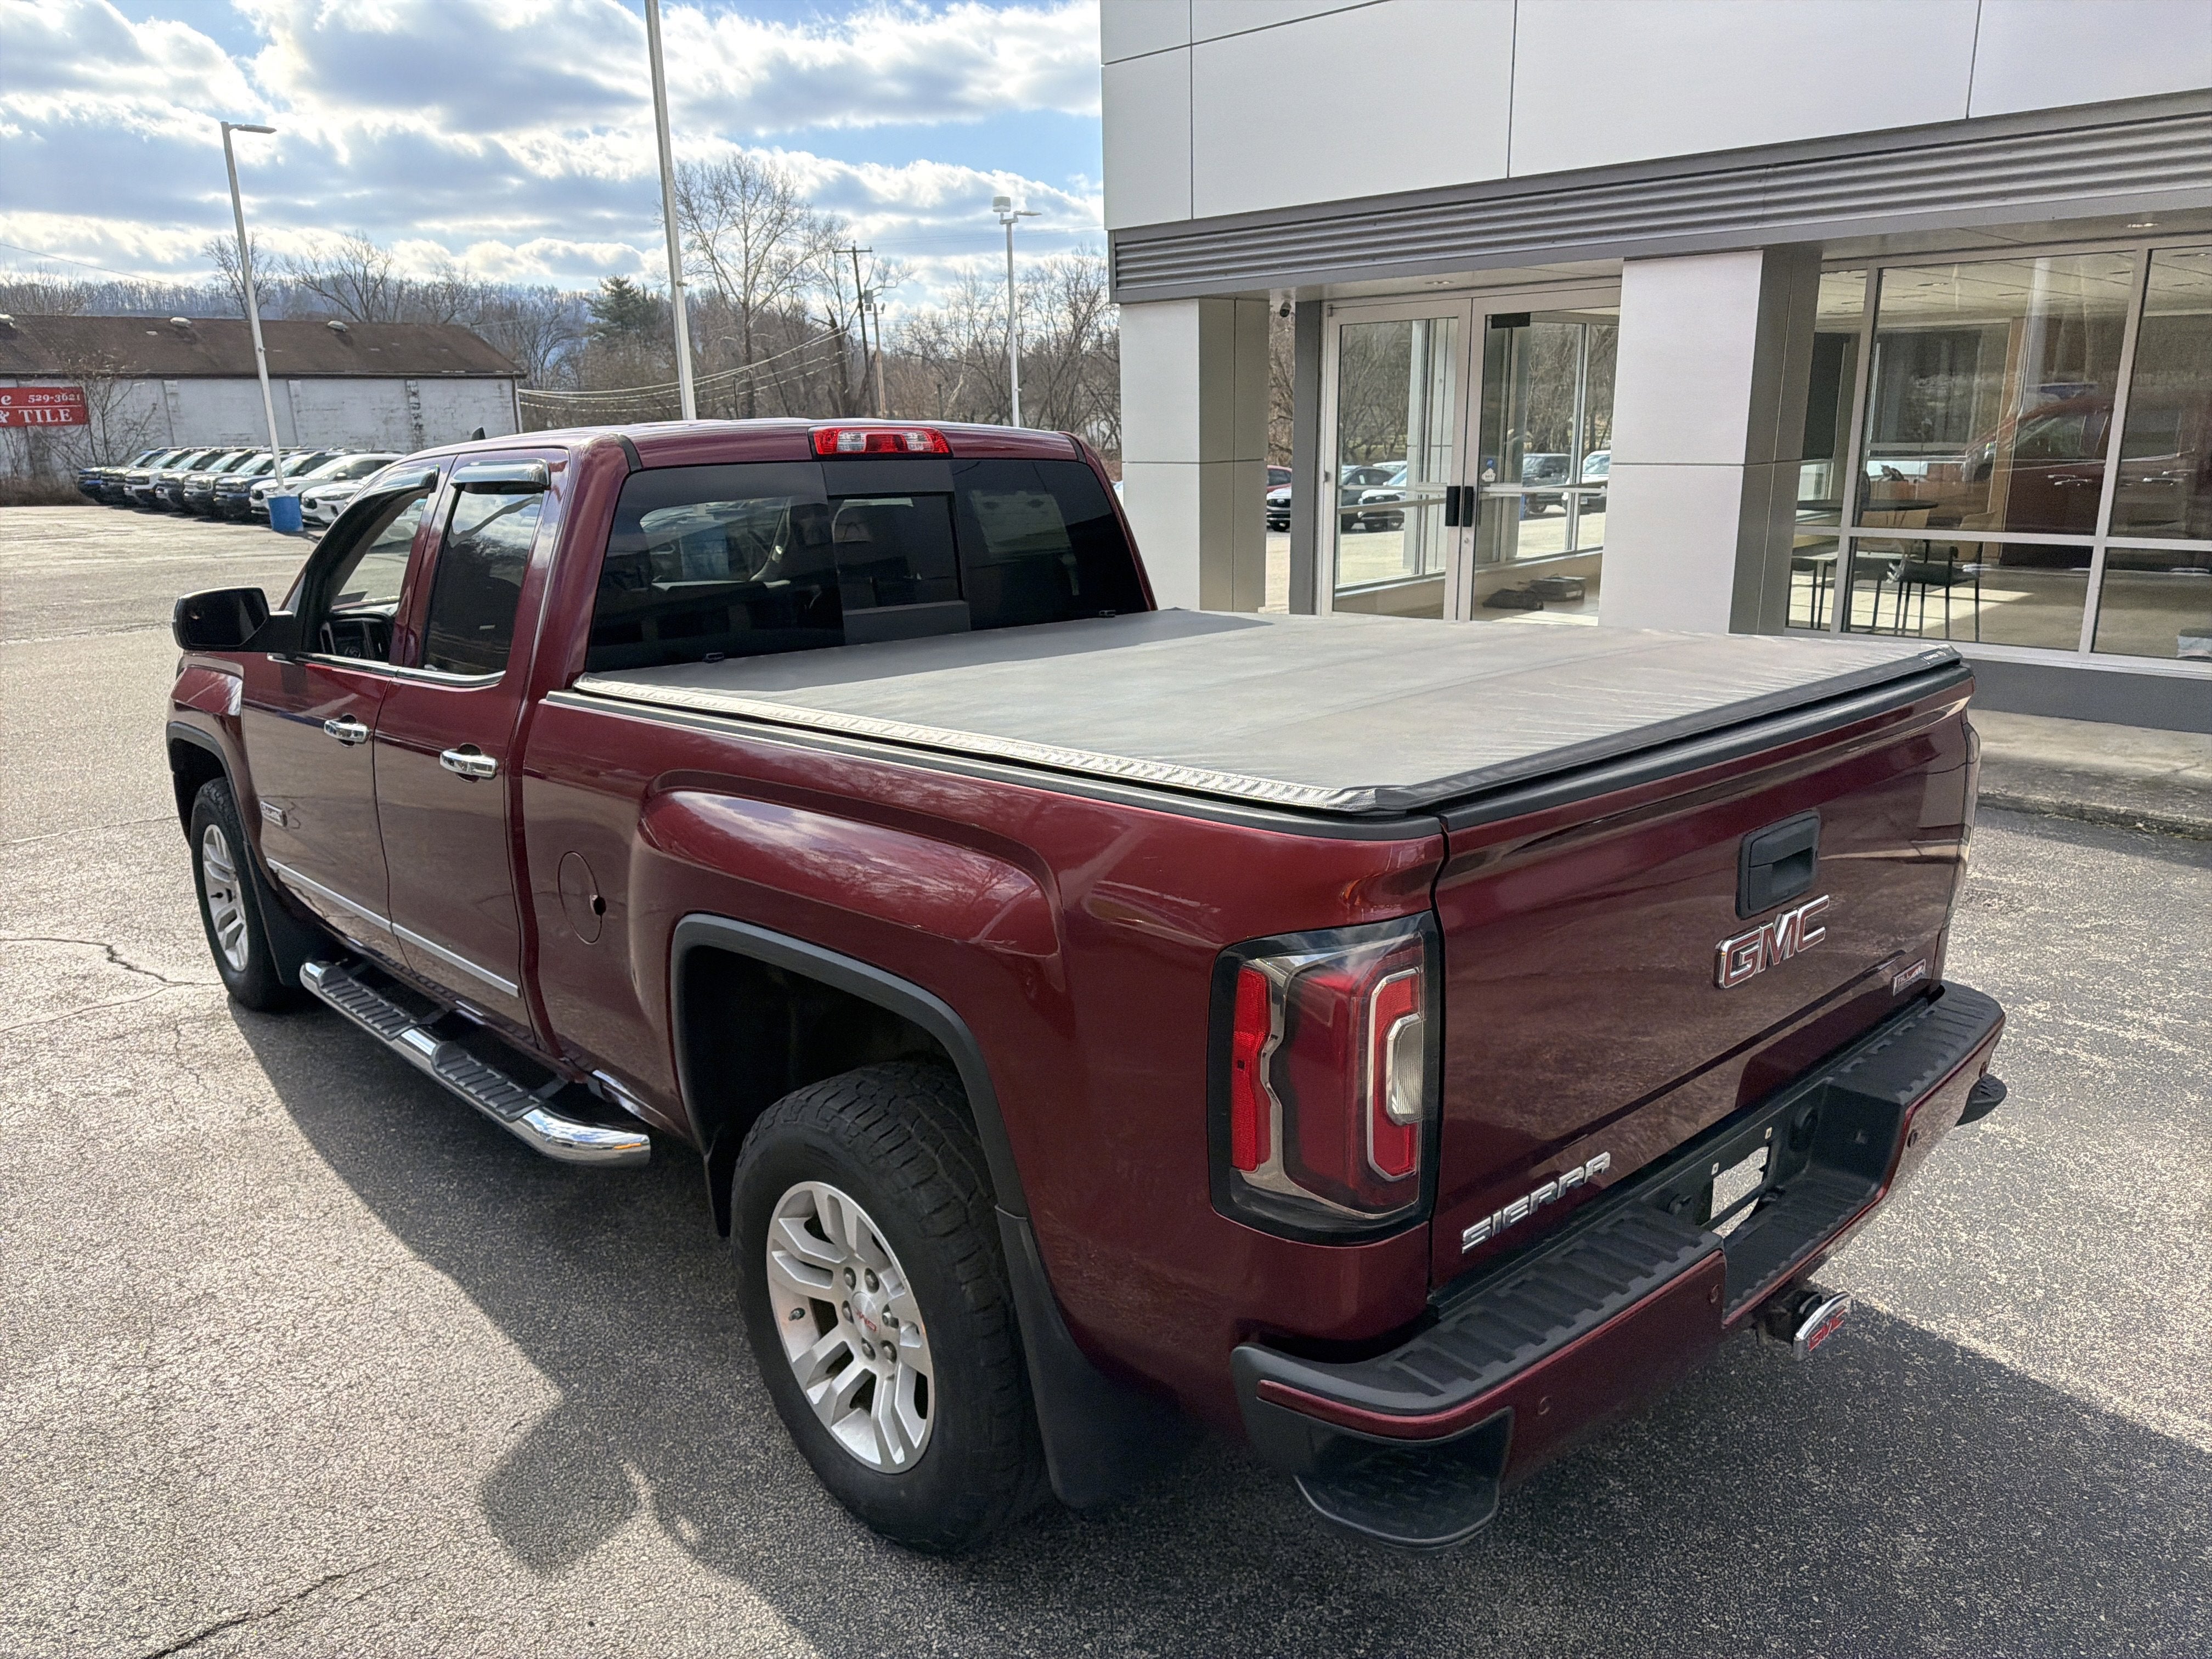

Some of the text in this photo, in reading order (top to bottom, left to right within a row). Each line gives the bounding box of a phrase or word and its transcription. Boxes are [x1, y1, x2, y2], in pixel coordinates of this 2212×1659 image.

[18, 408, 72, 424] TILE
[27, 393, 81, 404] 529-3621
[1715, 894, 1830, 989] GMC
[1462, 1151, 1611, 1254] SIERRA
